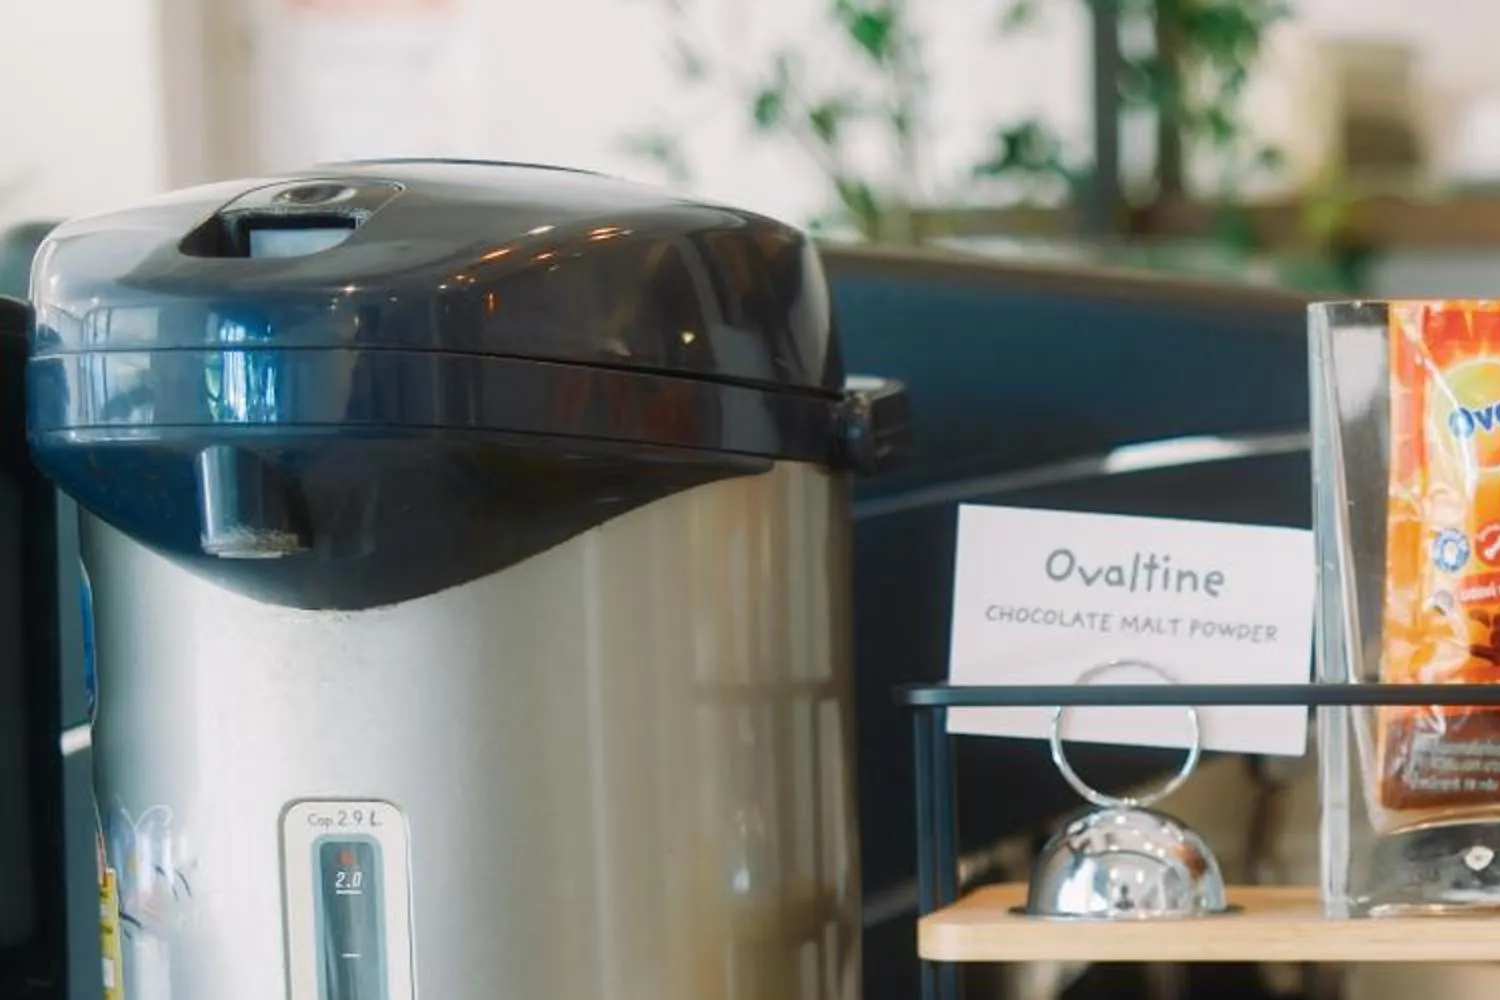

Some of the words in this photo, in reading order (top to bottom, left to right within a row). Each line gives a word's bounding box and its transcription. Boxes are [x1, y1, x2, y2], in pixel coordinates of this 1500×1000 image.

[1045, 547, 1225, 597] Ovaltine
[985, 604, 1111, 633] CHOCOLATE
[1120, 614, 1182, 637] MALT
[1189, 618, 1278, 643] POWDER
[335, 871, 362, 888] 2.0
